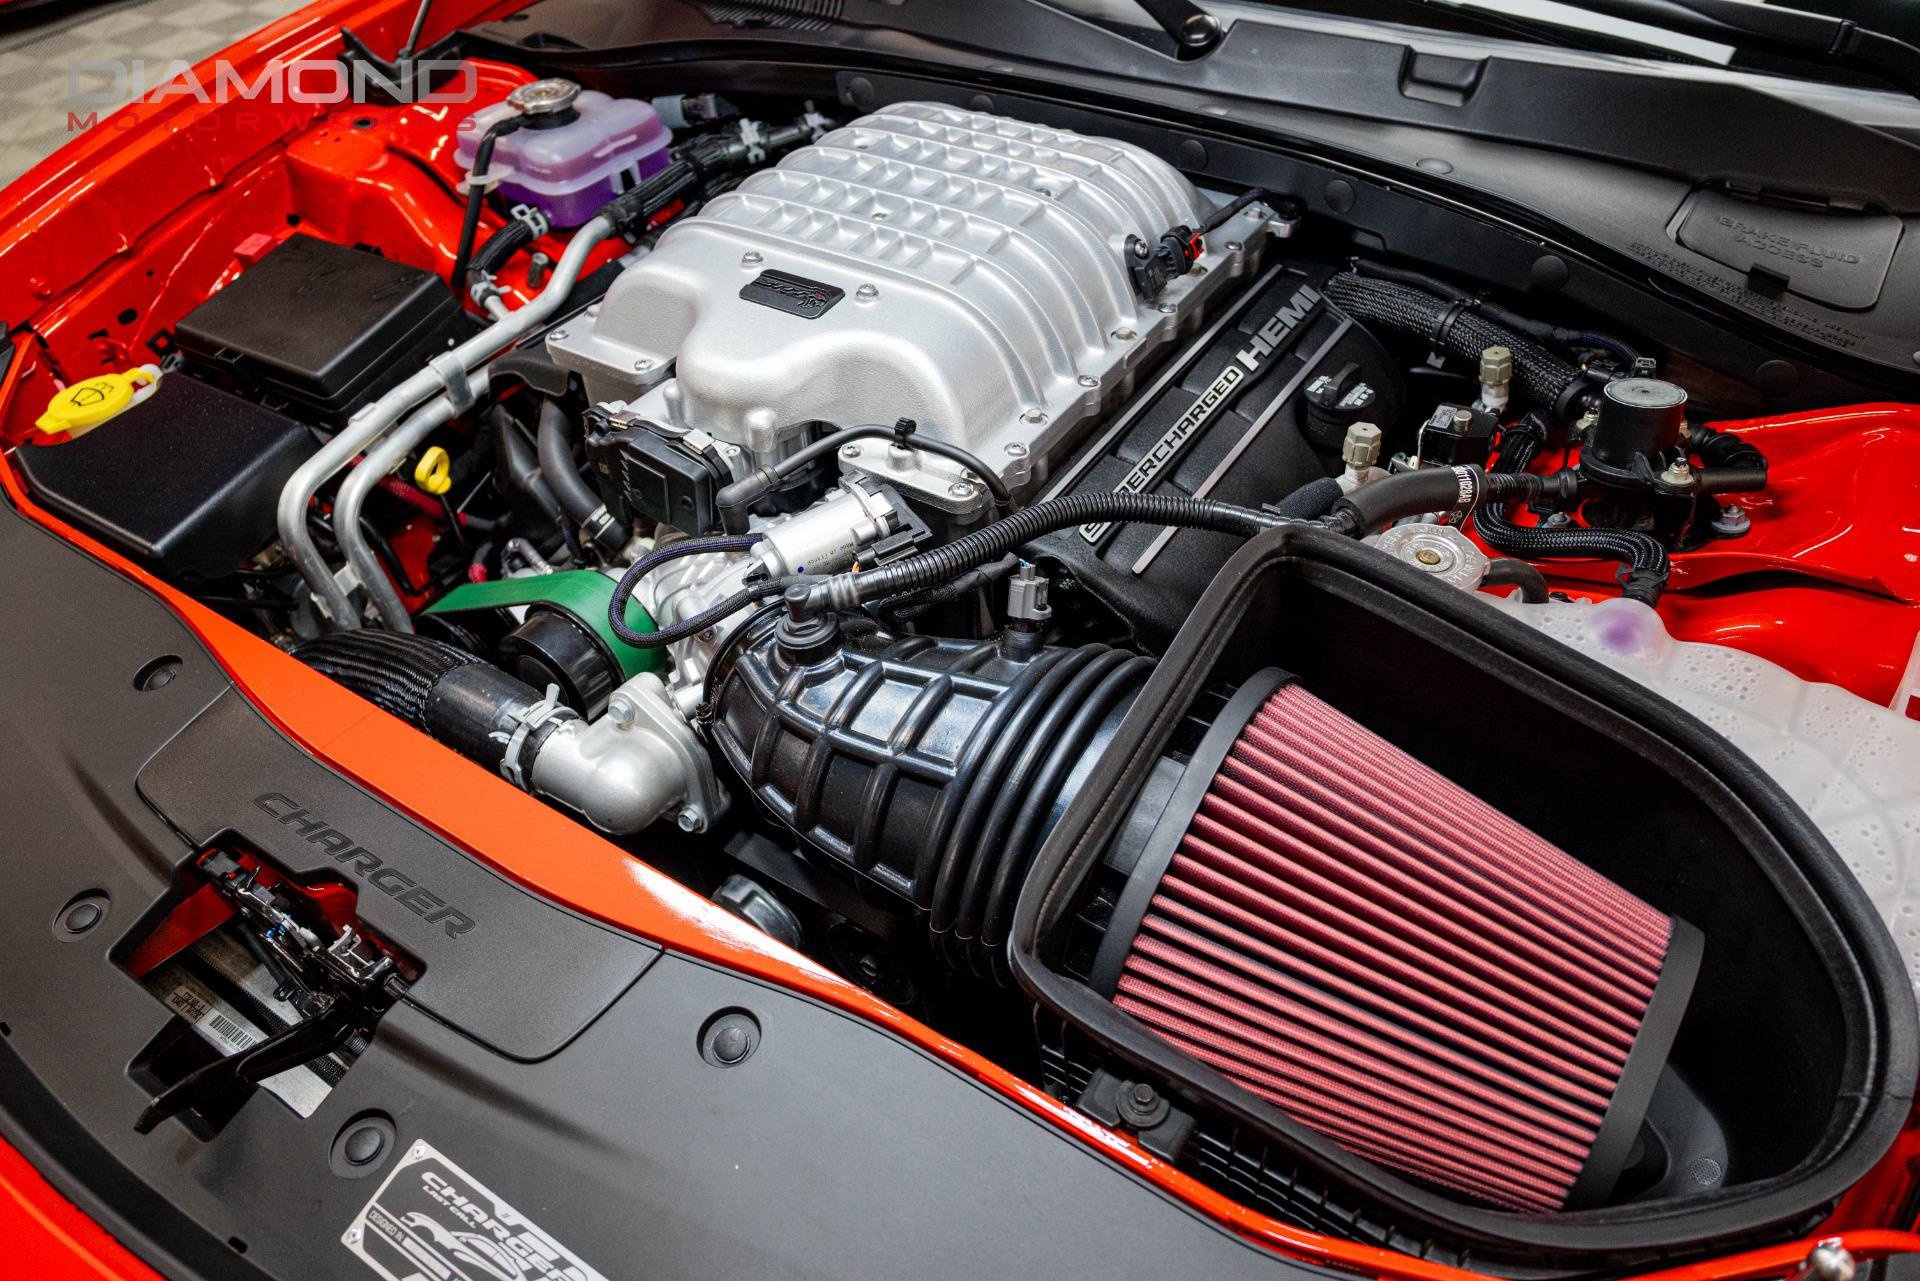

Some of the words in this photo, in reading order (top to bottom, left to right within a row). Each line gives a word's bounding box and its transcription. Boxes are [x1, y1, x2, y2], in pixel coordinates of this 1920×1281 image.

[1718, 216, 1790, 247] BRAKE
[1798, 243, 1860, 264] FLUID
[1736, 236, 1824, 268] ACCESS
[1085, 367, 1242, 538] SERCHARGED
[1236, 285, 1322, 372] HEMI
[253, 792, 477, 939] CHARGER
[422, 1185, 450, 1205] LAST
[449, 1206, 476, 1229] CALL
